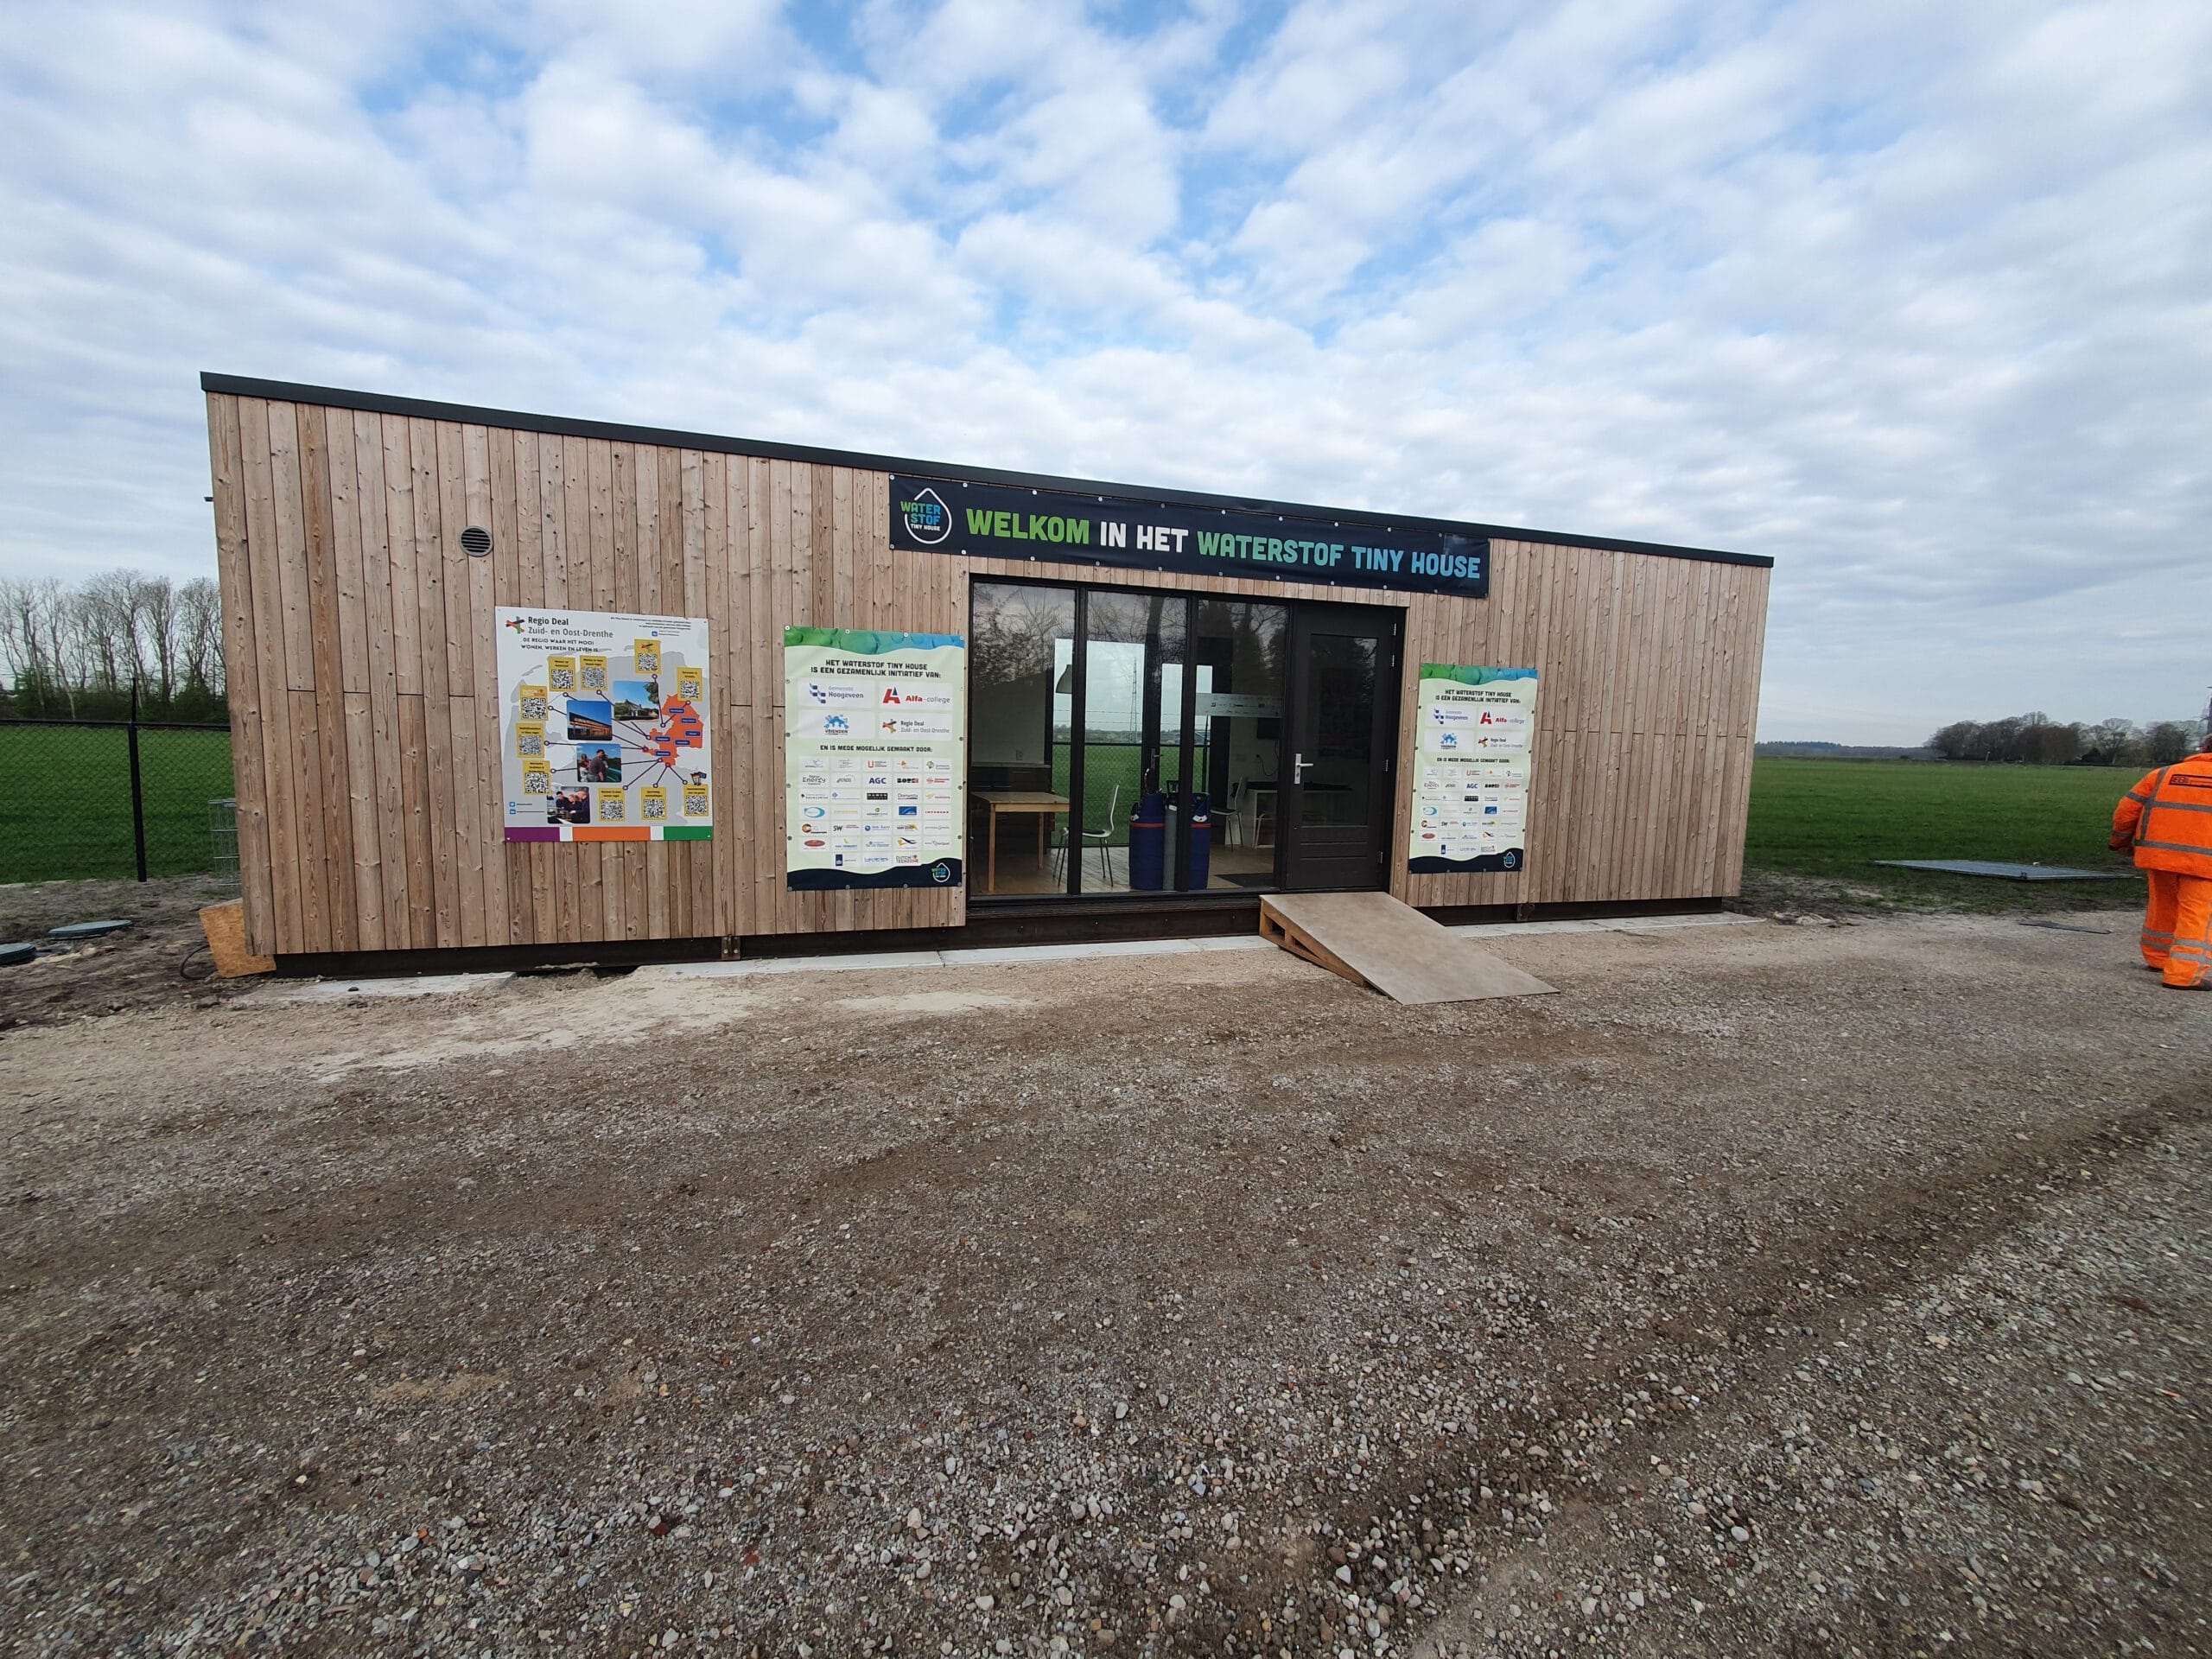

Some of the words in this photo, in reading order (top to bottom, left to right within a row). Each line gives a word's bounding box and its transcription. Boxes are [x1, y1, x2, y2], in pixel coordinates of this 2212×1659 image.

[900, 501, 941, 515] WATER
[910, 512, 941, 525] STOF
[966, 508, 1090, 544] WELKOM
[1100, 521, 1126, 548] IN
[1136, 524, 1189, 553] HET
[1197, 531, 1344, 567] WATERSTOF
[1351, 545, 1404, 572] TINY
[1411, 552, 1481, 579] HOUSE
[528, 617, 549, 626] Regio
[563, 628, 613, 638] Oost-Drenthe
[837, 668, 886, 676] GEZAMENLIJK
